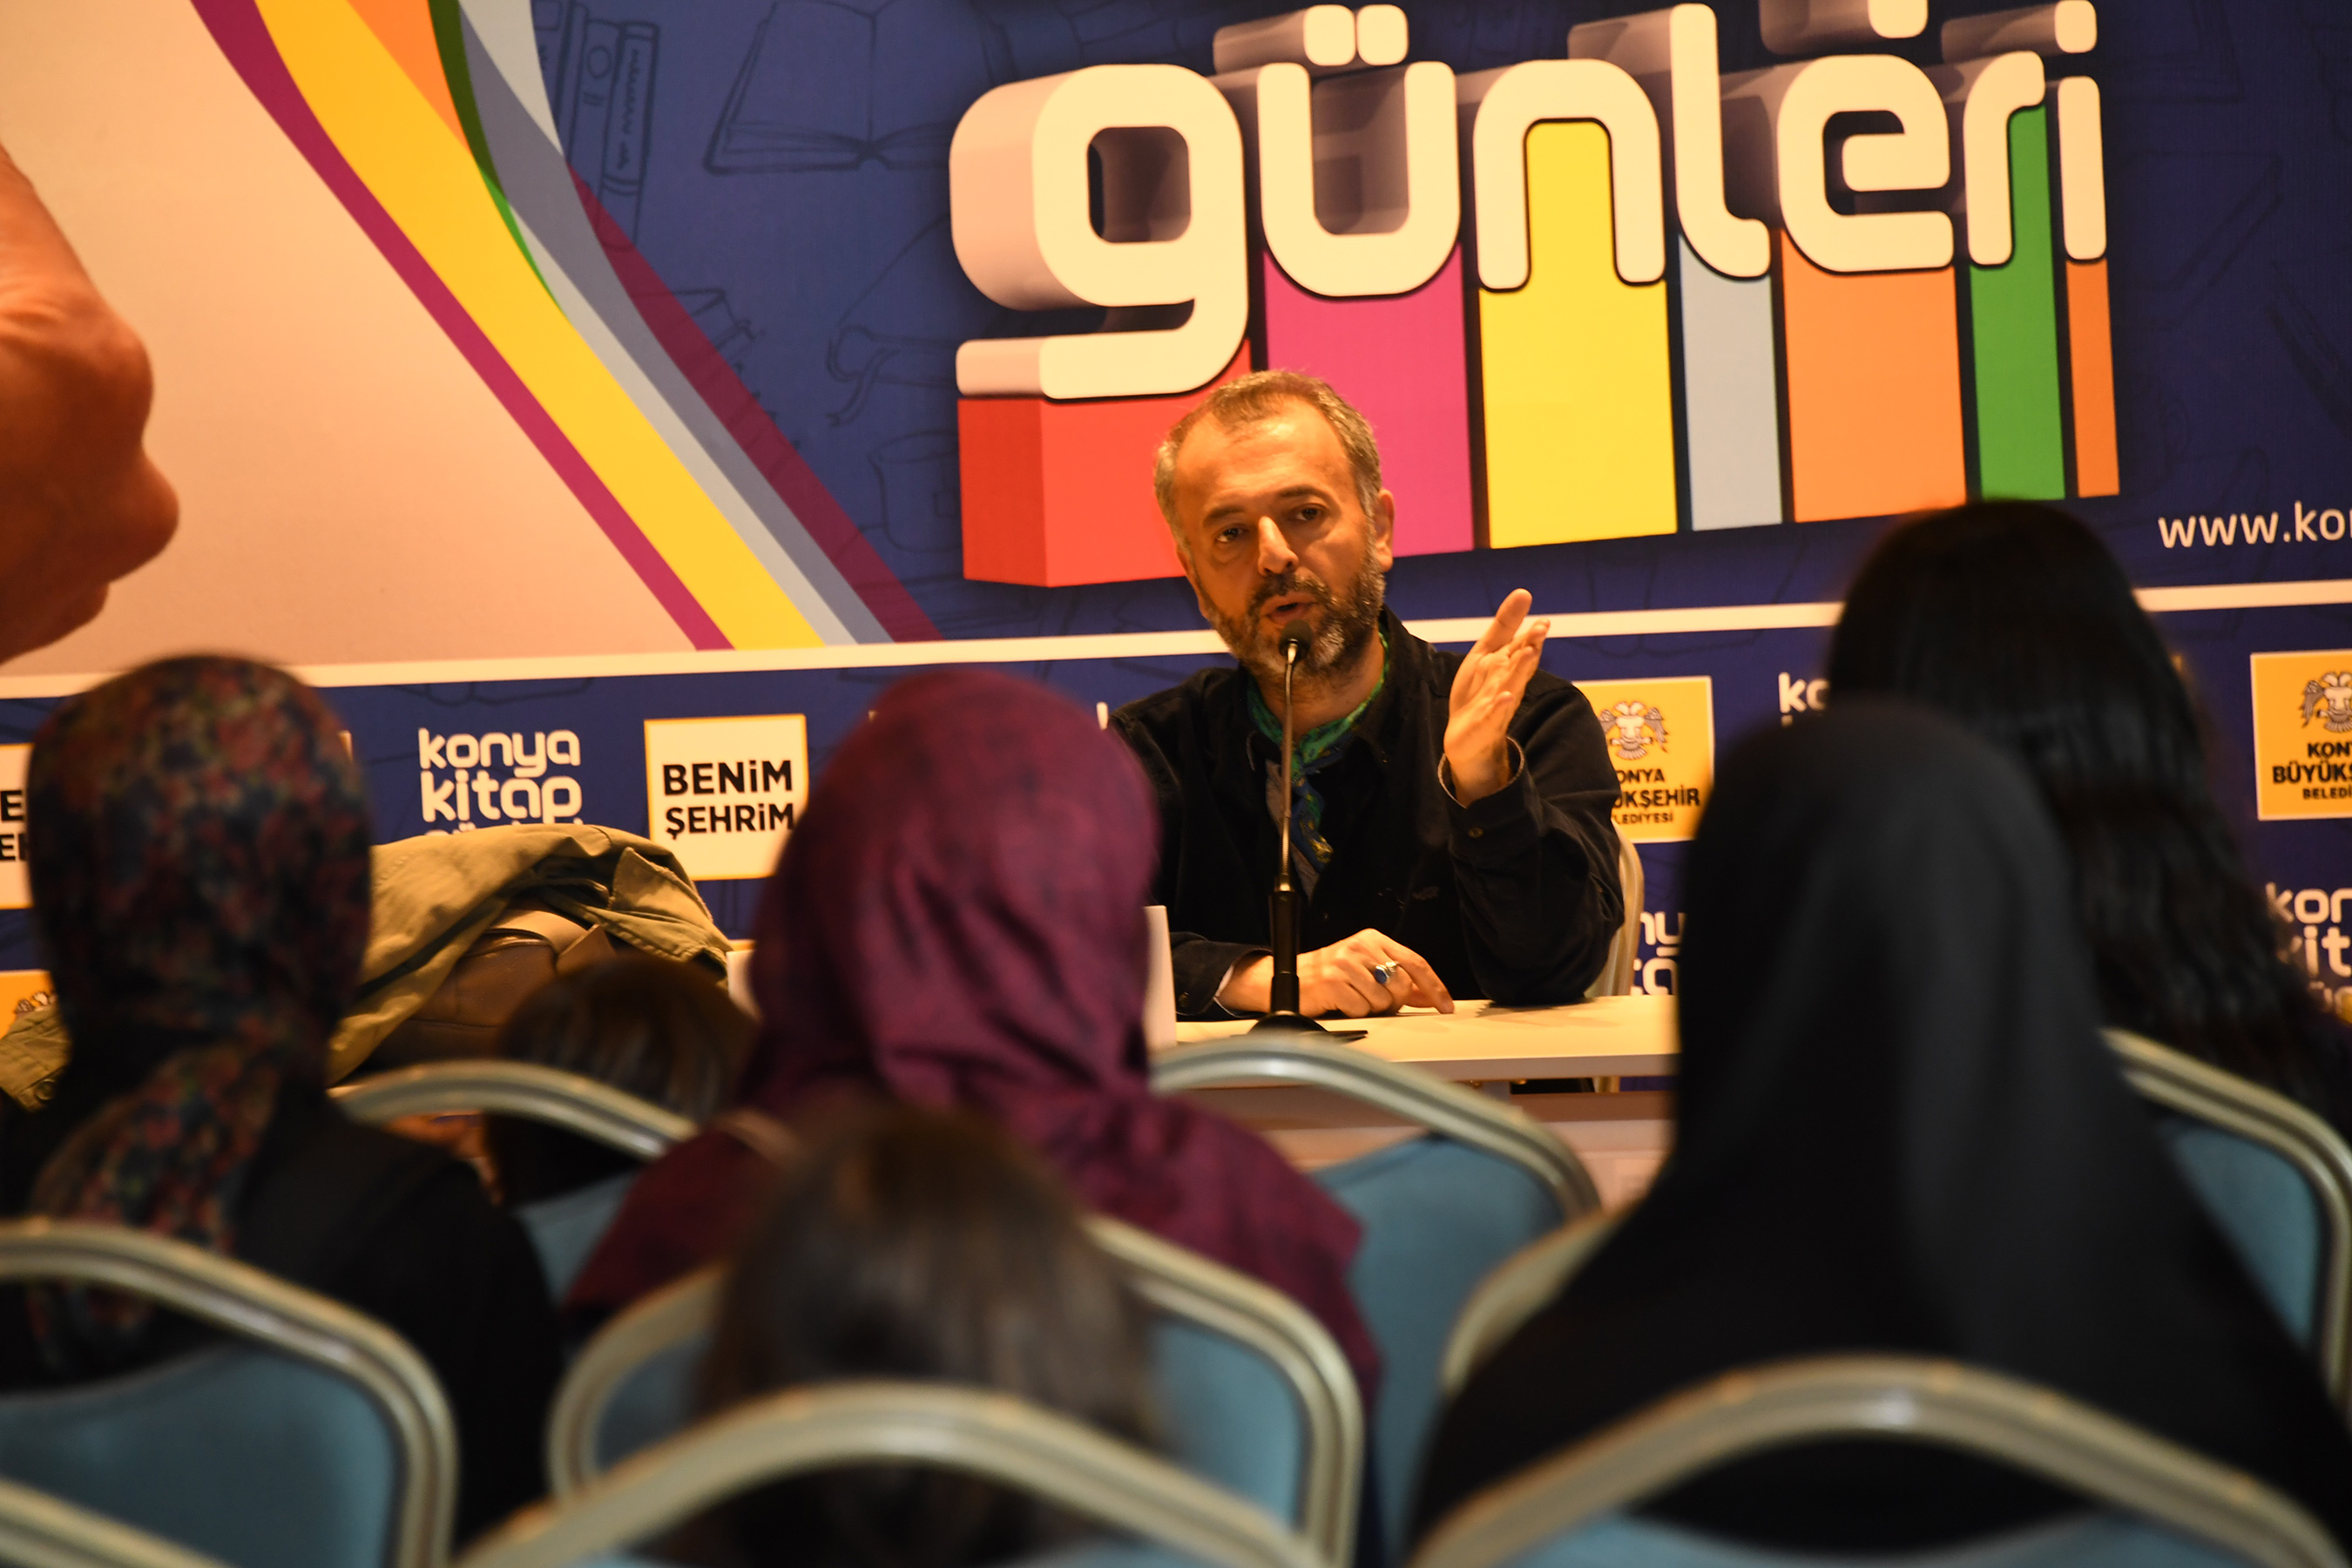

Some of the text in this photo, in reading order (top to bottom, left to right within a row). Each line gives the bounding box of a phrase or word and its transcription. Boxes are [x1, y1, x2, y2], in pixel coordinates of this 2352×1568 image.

[950, 0, 2107, 401] günleri
[2158, 499, 2352, 549] www.ko
[418, 727, 581, 778] konya
[2272, 760, 2352, 784] BÜYÜK
[2307, 741, 2352, 759] KON
[421, 769, 583, 824] kitap
[1614, 768, 1665, 785] ONYA
